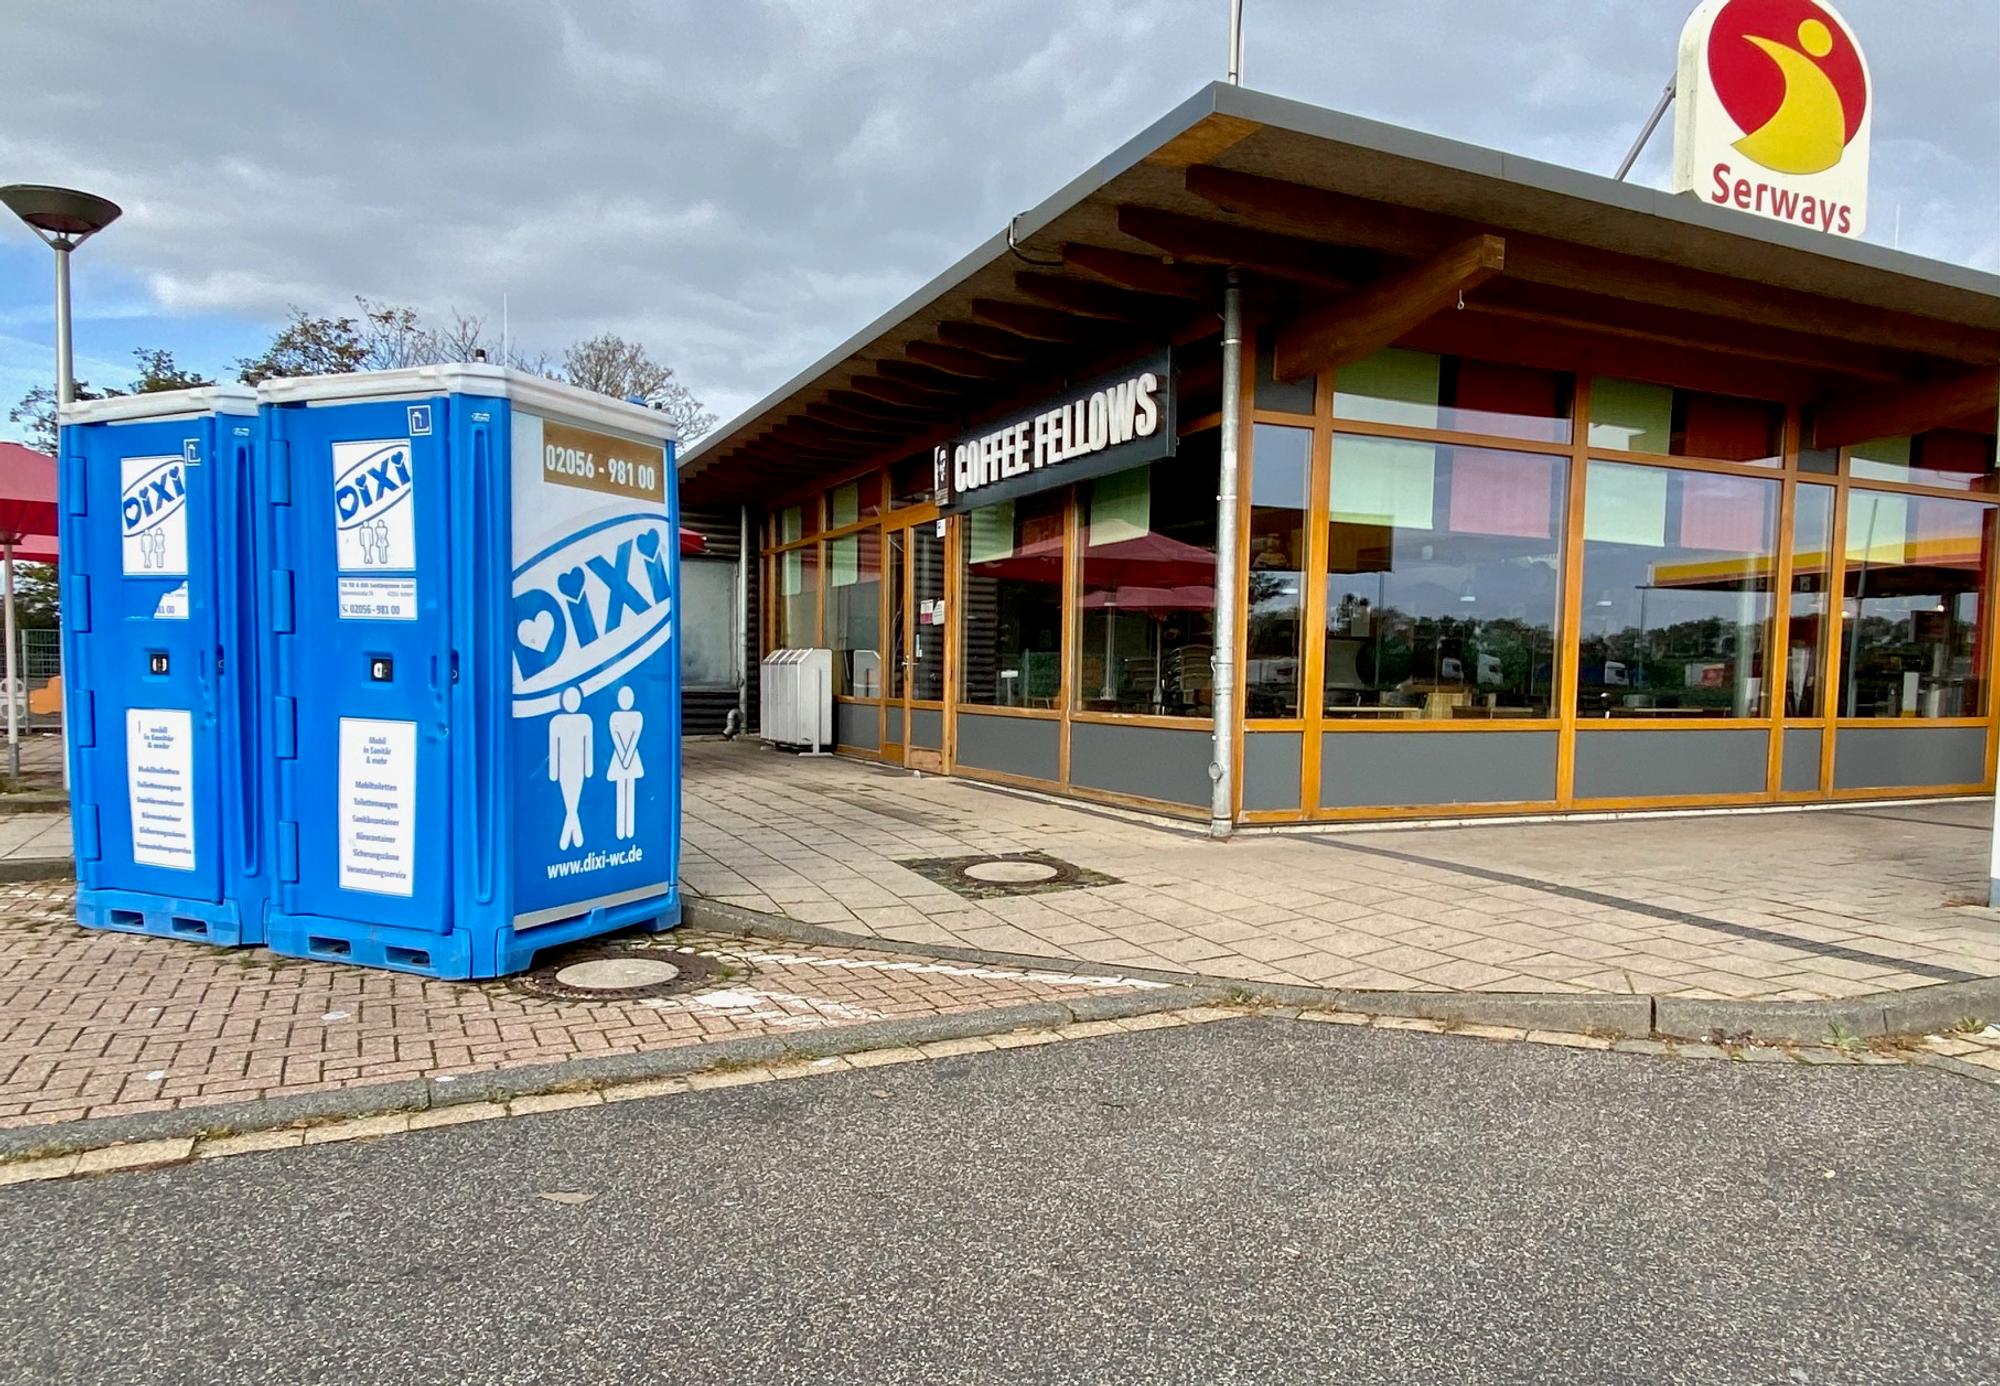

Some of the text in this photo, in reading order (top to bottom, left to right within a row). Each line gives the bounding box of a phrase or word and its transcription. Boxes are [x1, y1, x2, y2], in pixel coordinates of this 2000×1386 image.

[1711, 163, 1851, 234] Serways
[955, 372, 1158, 493] COFFEE FELLOWS
[546, 444, 595, 479] 02056
[608, 459, 635, 487] 981
[638, 465, 655, 490] 00
[350, 604, 372, 615] 02056
[376, 604, 389, 615] 981
[391, 605, 401, 615] 00
[372, 756, 388, 766] mehr
[547, 844, 643, 879] www.dixi-wc.de
